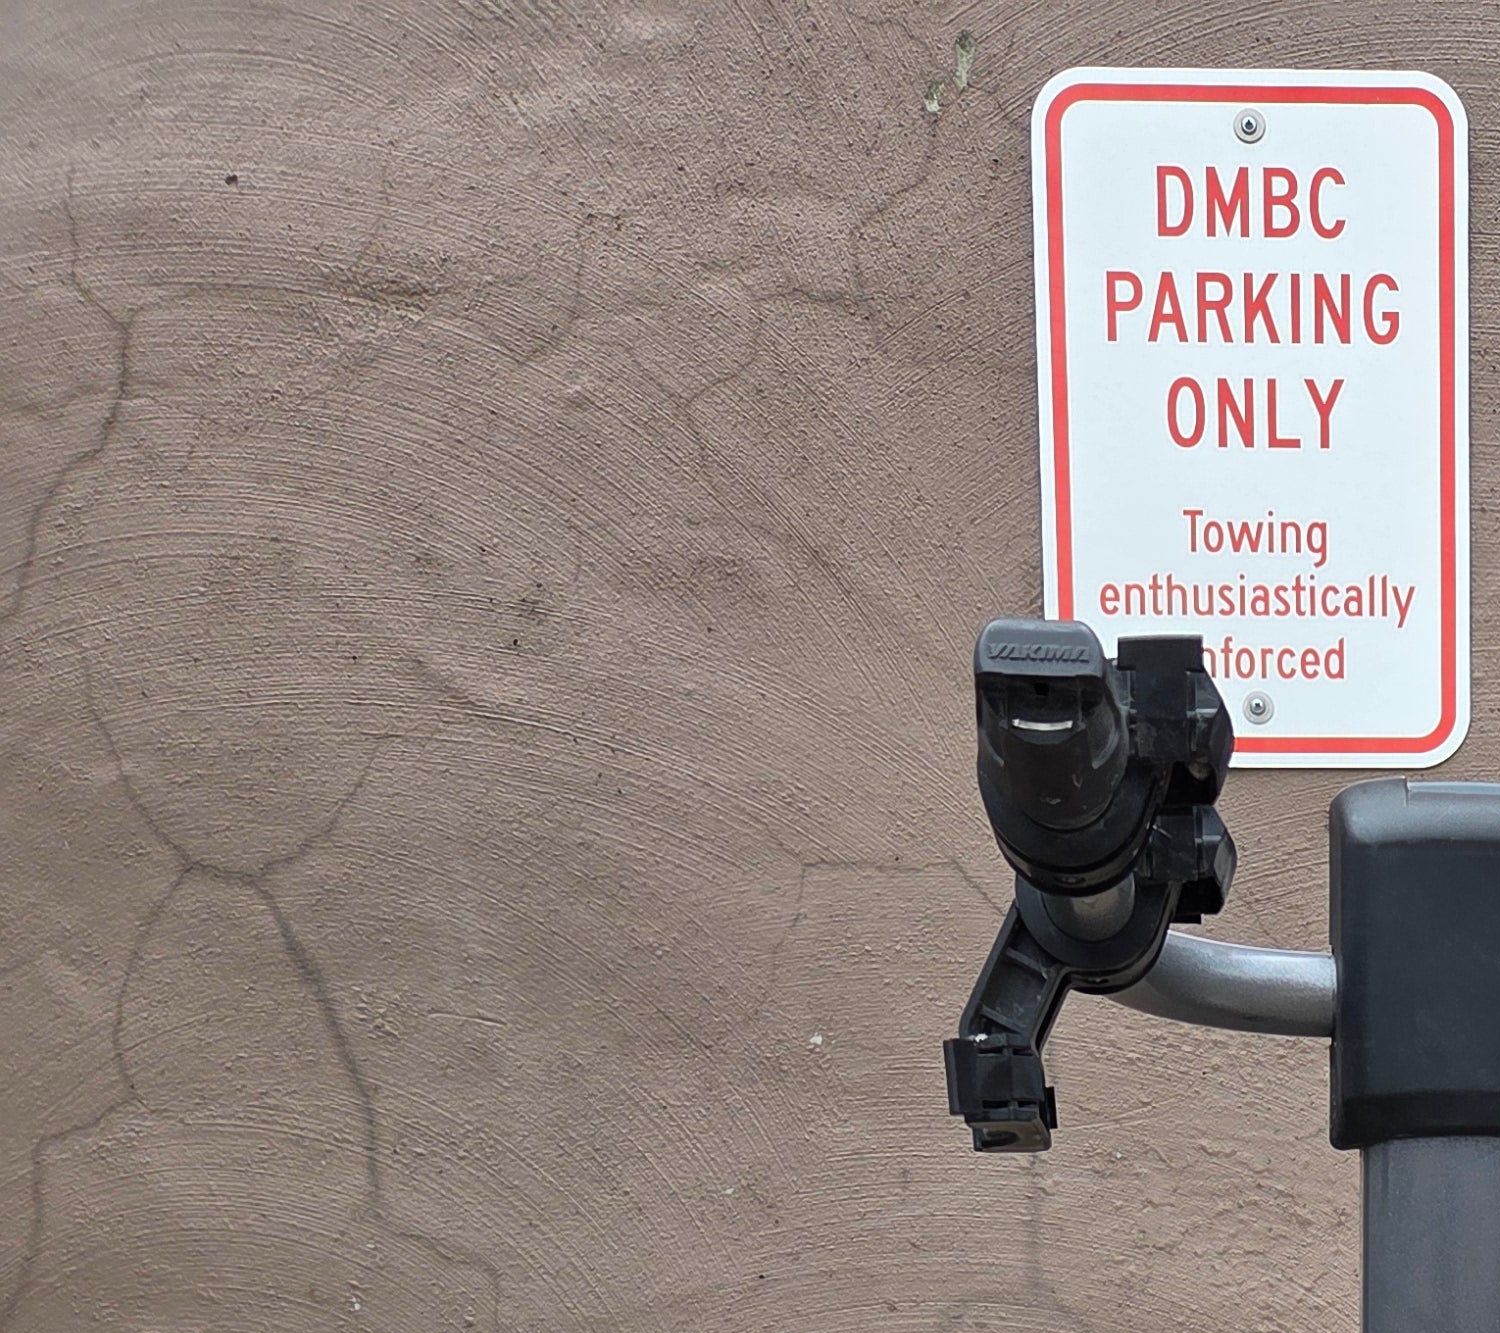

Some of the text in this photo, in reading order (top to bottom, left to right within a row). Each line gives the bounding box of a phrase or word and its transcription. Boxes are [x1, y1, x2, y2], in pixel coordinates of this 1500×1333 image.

[1156, 165, 1346, 239] DMBC
[1105, 271, 1400, 345] PARKING
[1166, 377, 1344, 449] ONLY
[1183, 509, 1328, 567] Towing
[1100, 575, 1414, 627] enthusiastically
[988, 643, 1090, 664] YAKIMA
[1203, 637, 1345, 679] nforced
